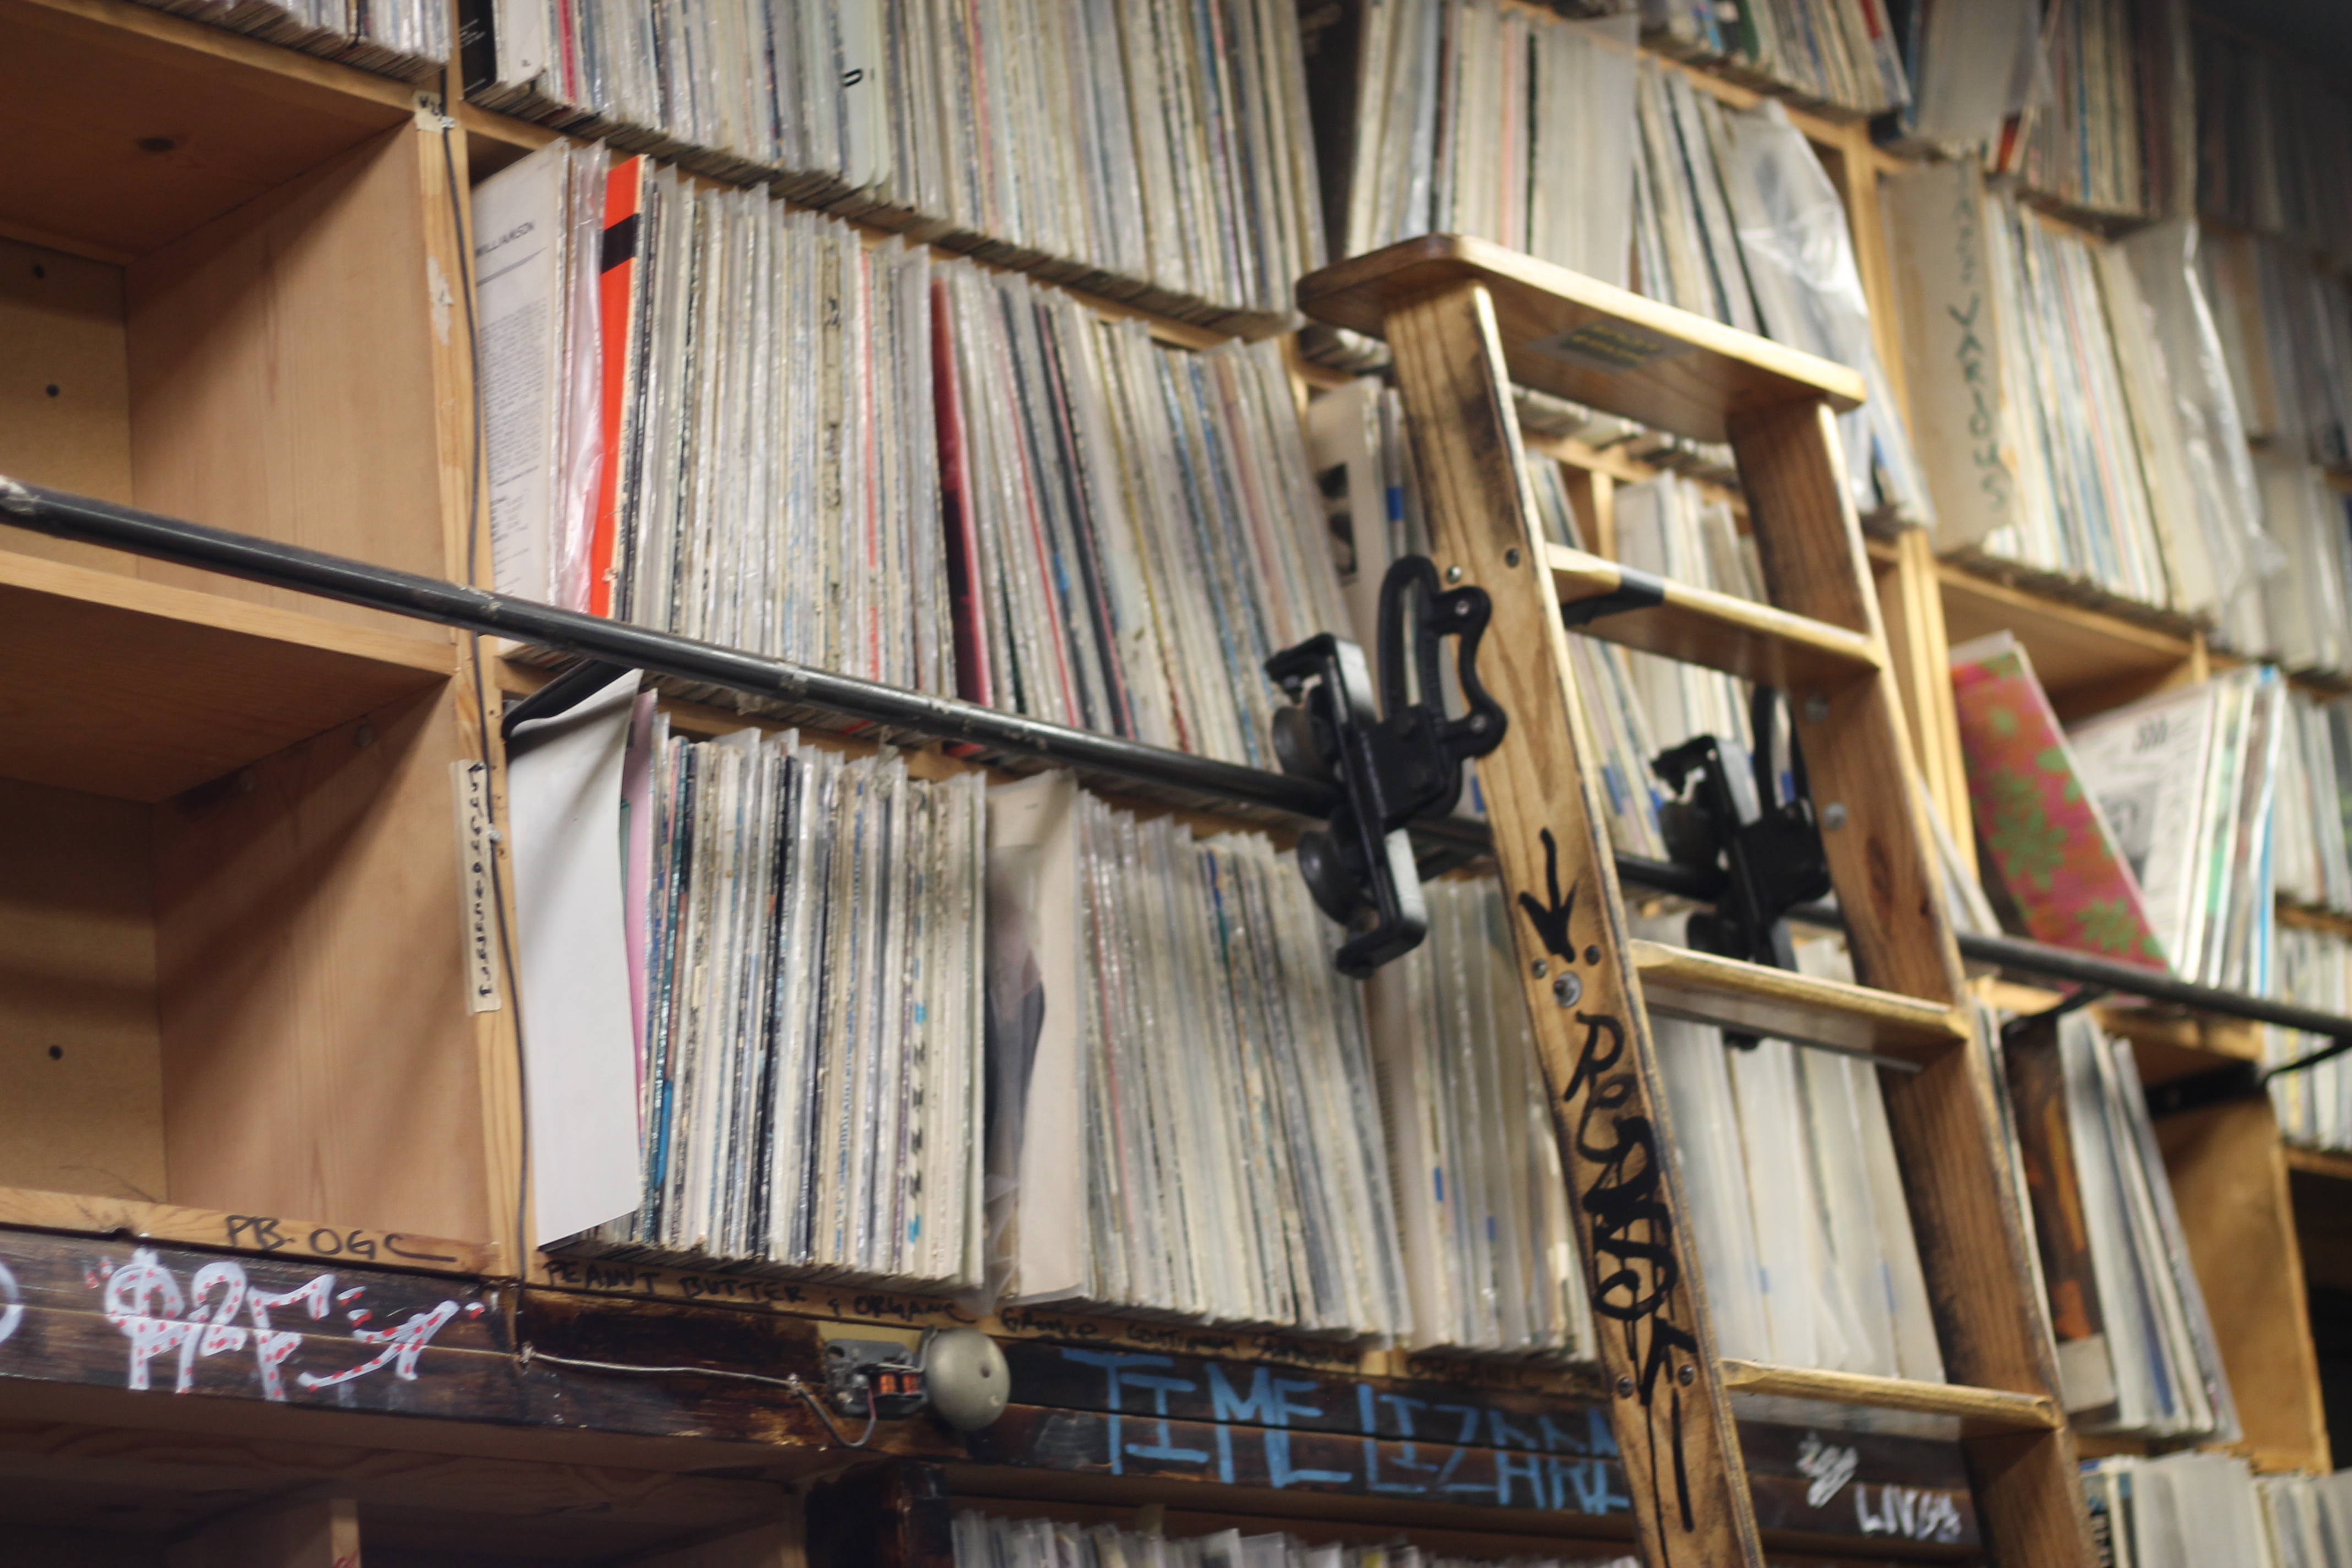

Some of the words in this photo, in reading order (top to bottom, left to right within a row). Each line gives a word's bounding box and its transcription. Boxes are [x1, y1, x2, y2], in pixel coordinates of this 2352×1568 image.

[543, 1260, 661, 1296] PEANUT
[678, 1275, 807, 1304] BUTTER
[1061, 1347, 1353, 1489] TIME
